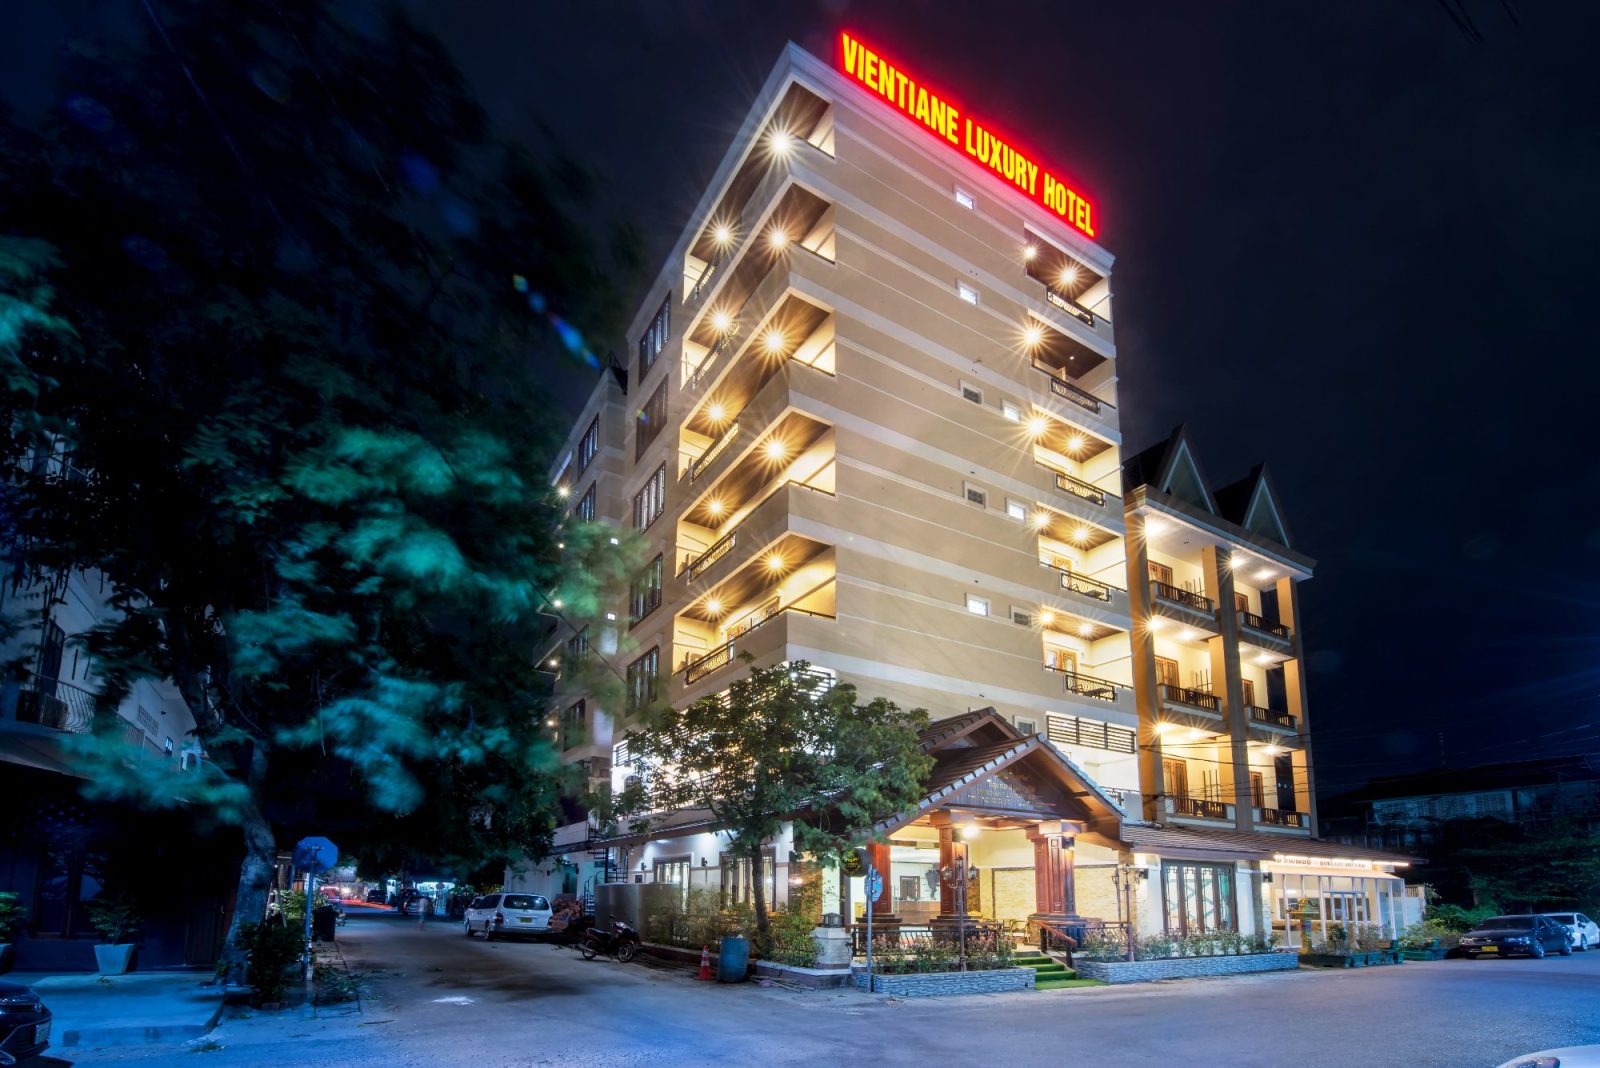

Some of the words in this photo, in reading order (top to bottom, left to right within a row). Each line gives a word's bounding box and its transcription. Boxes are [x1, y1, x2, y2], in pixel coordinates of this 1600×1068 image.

[842, 33, 959, 145] VIENTIANE
[965, 119, 1038, 195] LUXURY
[1044, 172, 1095, 237] HOTEL
